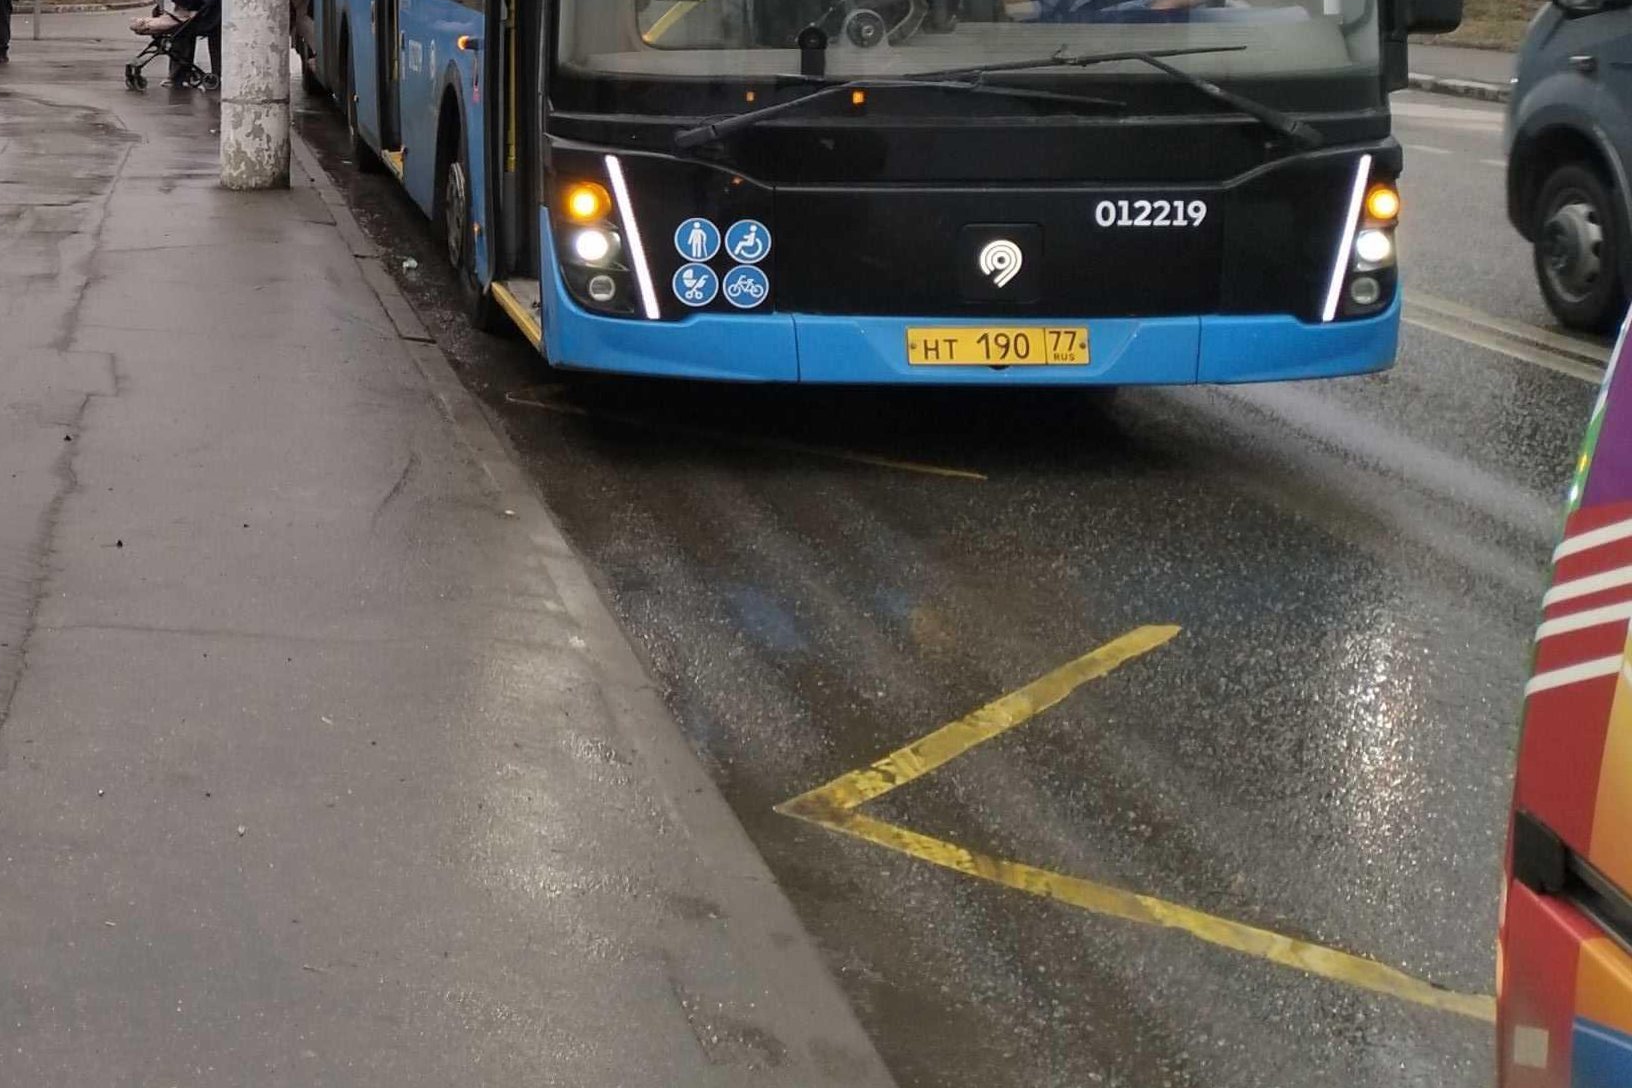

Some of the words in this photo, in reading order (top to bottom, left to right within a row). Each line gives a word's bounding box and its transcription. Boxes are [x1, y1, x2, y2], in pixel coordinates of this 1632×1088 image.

[1095, 200, 1208, 227] 012219
[975, 332, 1030, 360] 190
[1048, 330, 1077, 352] 77
[1053, 353, 1076, 362] RUS
